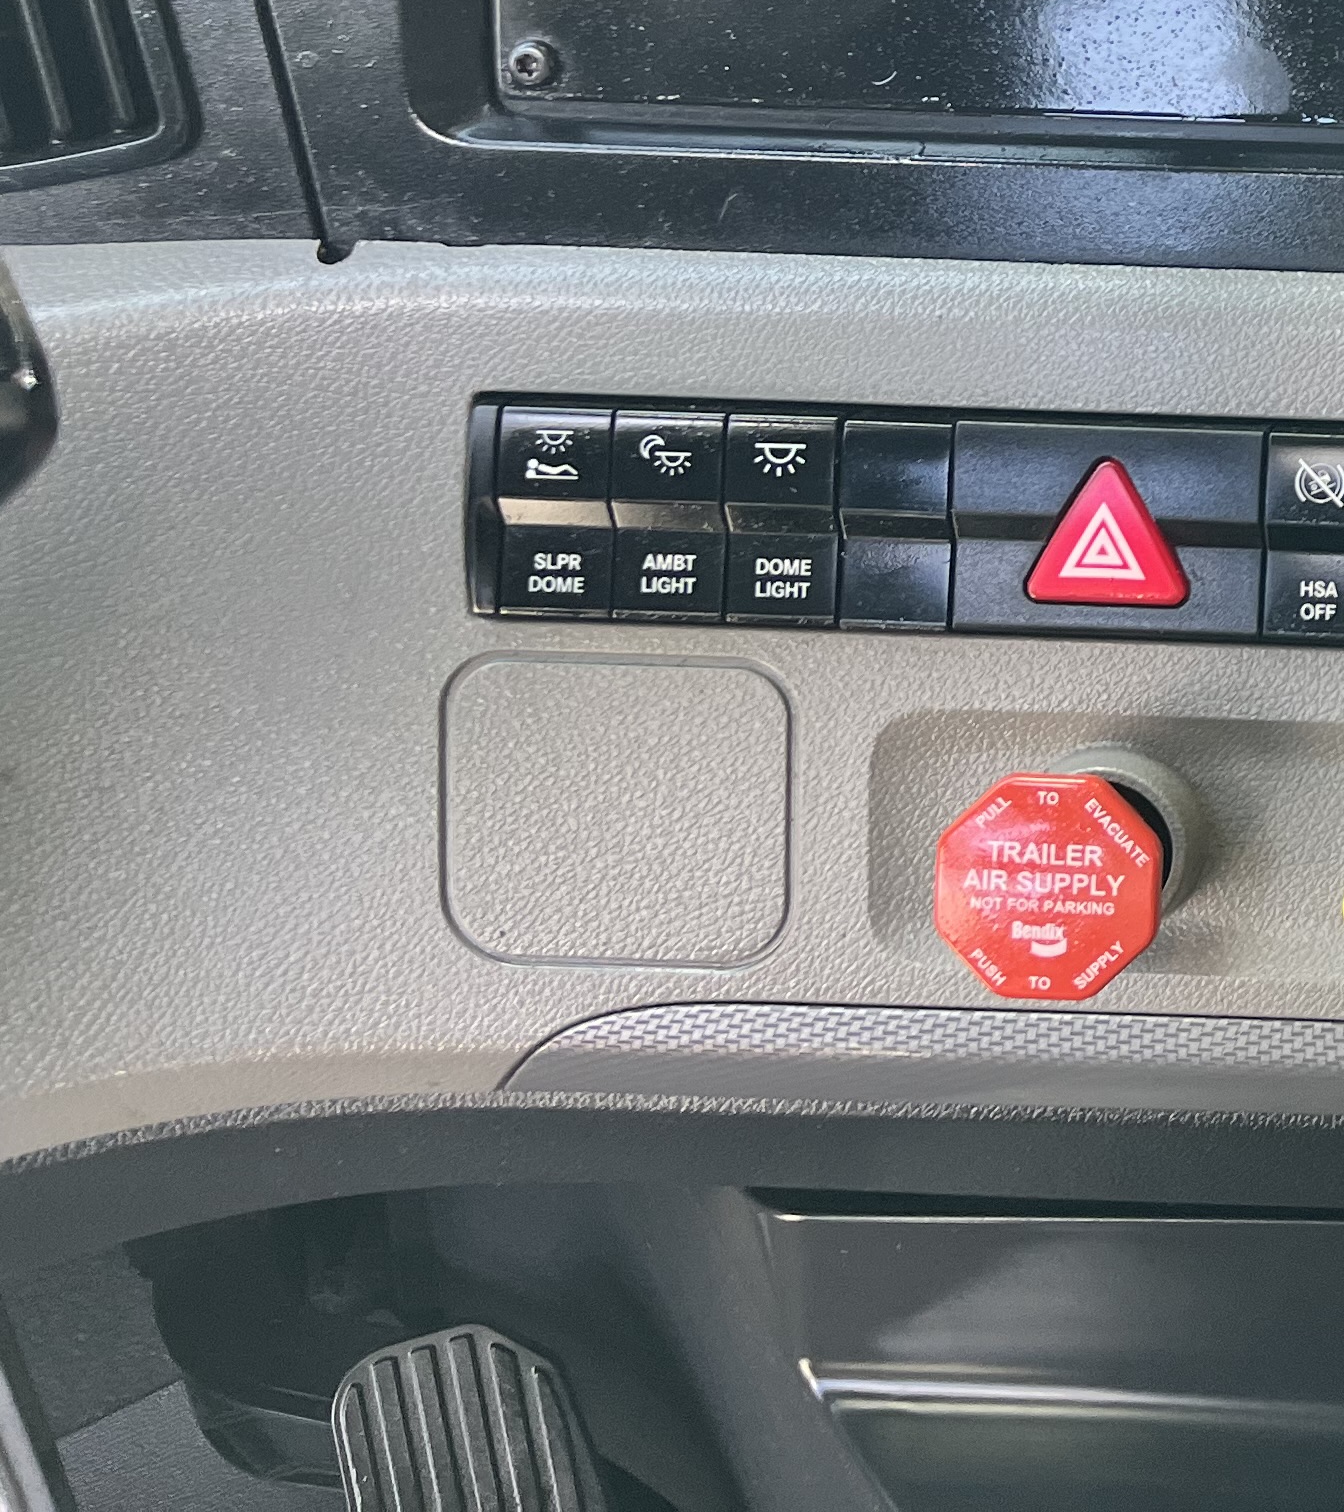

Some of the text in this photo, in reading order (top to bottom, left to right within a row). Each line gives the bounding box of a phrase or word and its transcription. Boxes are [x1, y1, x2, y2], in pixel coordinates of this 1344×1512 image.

[533, 553, 582, 571] SLPR
[641, 554, 697, 572] AMBT
[755, 558, 812, 576] DOME
[528, 576, 585, 594] DOME
[641, 576, 697, 595] LIGHT
[754, 581, 810, 600] LIGHT
[1299, 580, 1339, 599] HSA
[1299, 603, 1337, 621] OFF
[974, 790, 1152, 868] PULL TO EVACUATE
[987, 840, 1104, 868] TRAILER
[963, 868, 1126, 897] AIR SUPPLY
[969, 896, 1116, 916] NOT FOR PARKING
[1011, 920, 1068, 940] Bendix
[969, 940, 1125, 990] PUSH TO SUPPLY
